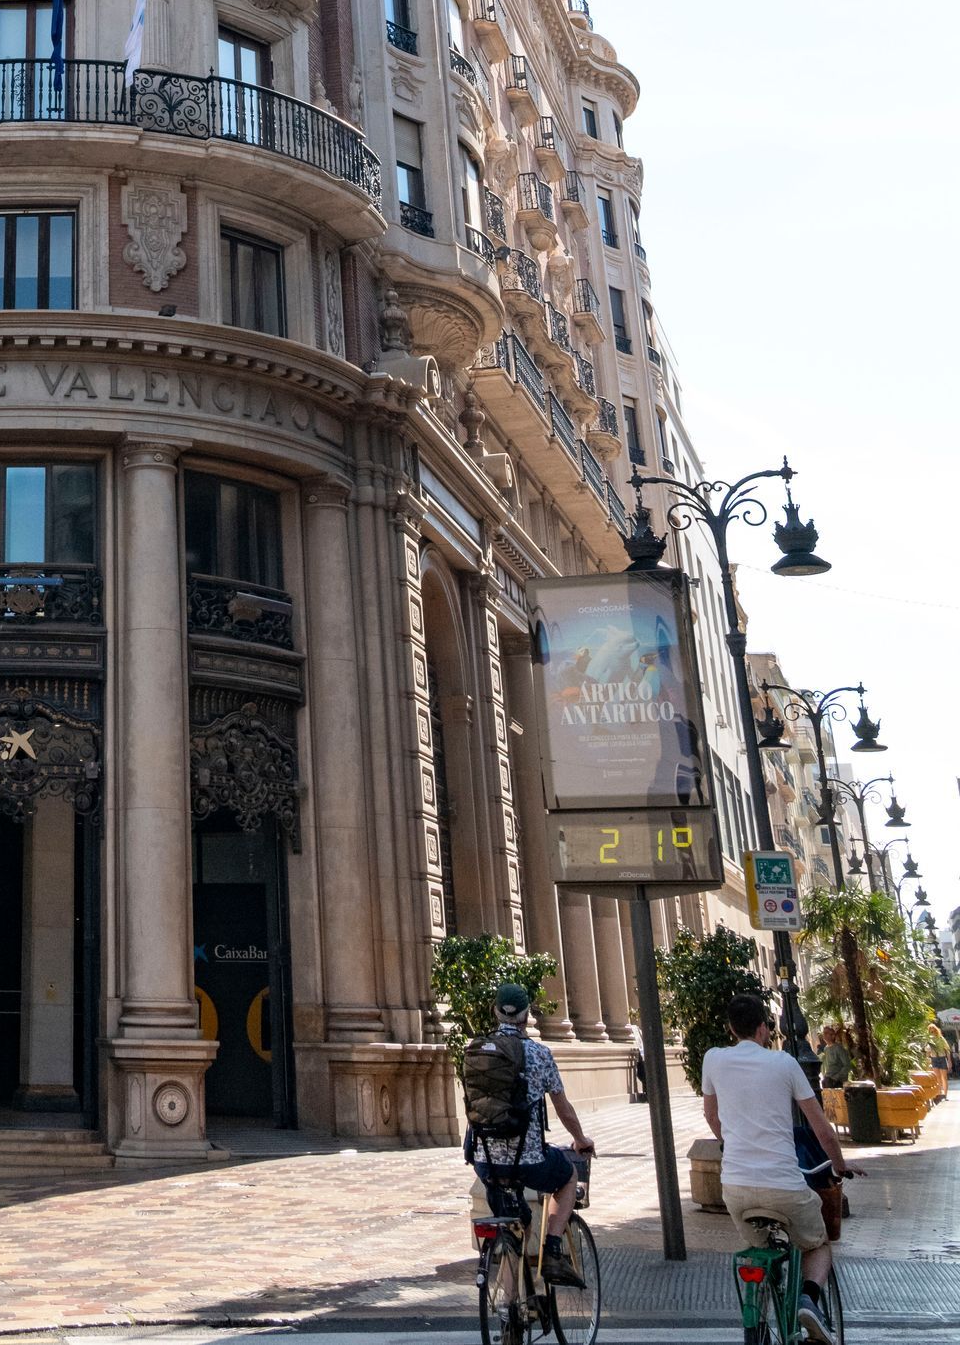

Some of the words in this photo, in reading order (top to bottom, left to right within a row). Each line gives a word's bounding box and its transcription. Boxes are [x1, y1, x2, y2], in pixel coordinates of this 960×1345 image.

[36, 361, 285, 427] VALENCIA
[579, 680, 653, 702] ÁRTICO
[560, 701, 675, 725] ANTÁRTICO
[214, 944, 268, 959] CaixaBa
